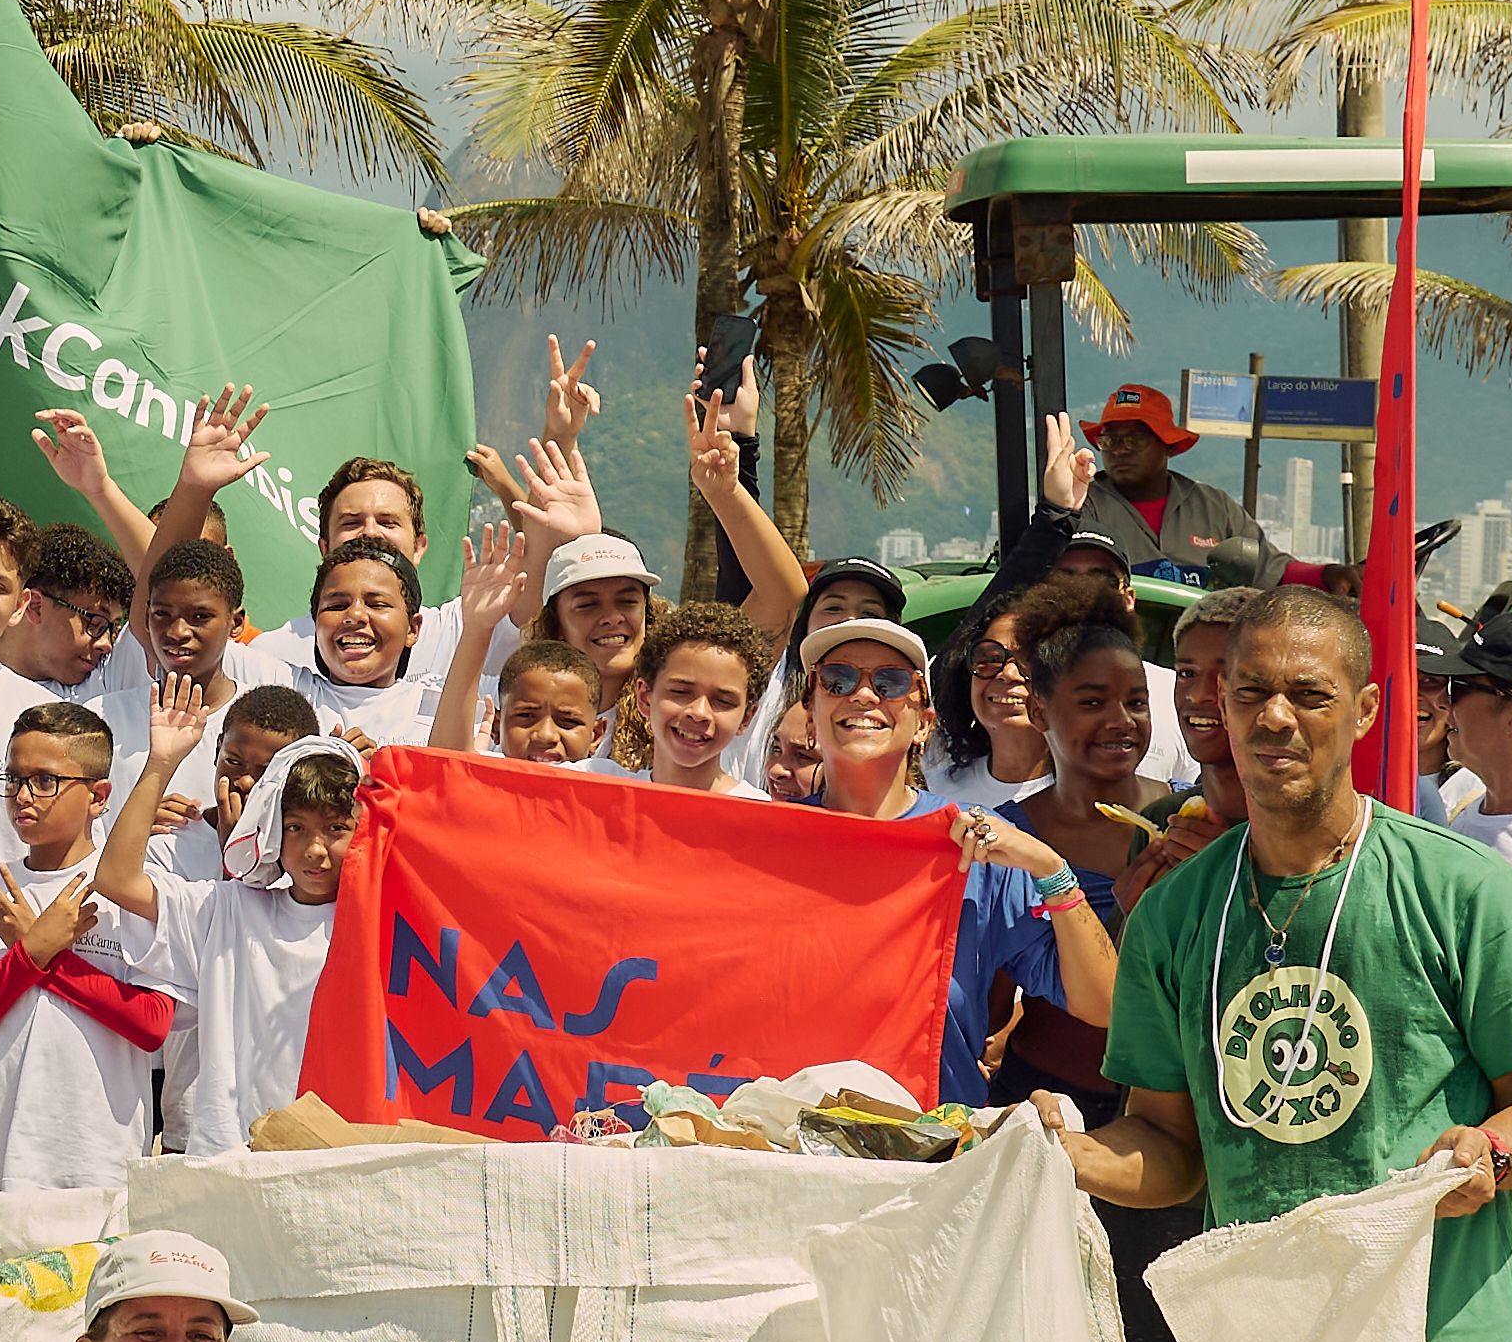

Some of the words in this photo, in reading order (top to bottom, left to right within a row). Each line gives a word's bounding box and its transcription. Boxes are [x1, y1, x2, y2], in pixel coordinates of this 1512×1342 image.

[1267, 380, 1294, 393] Largo
[1295, 380, 1309, 391] do
[388, 910, 658, 1036] NAS
[1225, 1015, 1257, 1060] DE
[1249, 984, 1336, 1022] OLHO
[1329, 1003, 1359, 1049] NO
[384, 1017, 754, 1138] MAR
